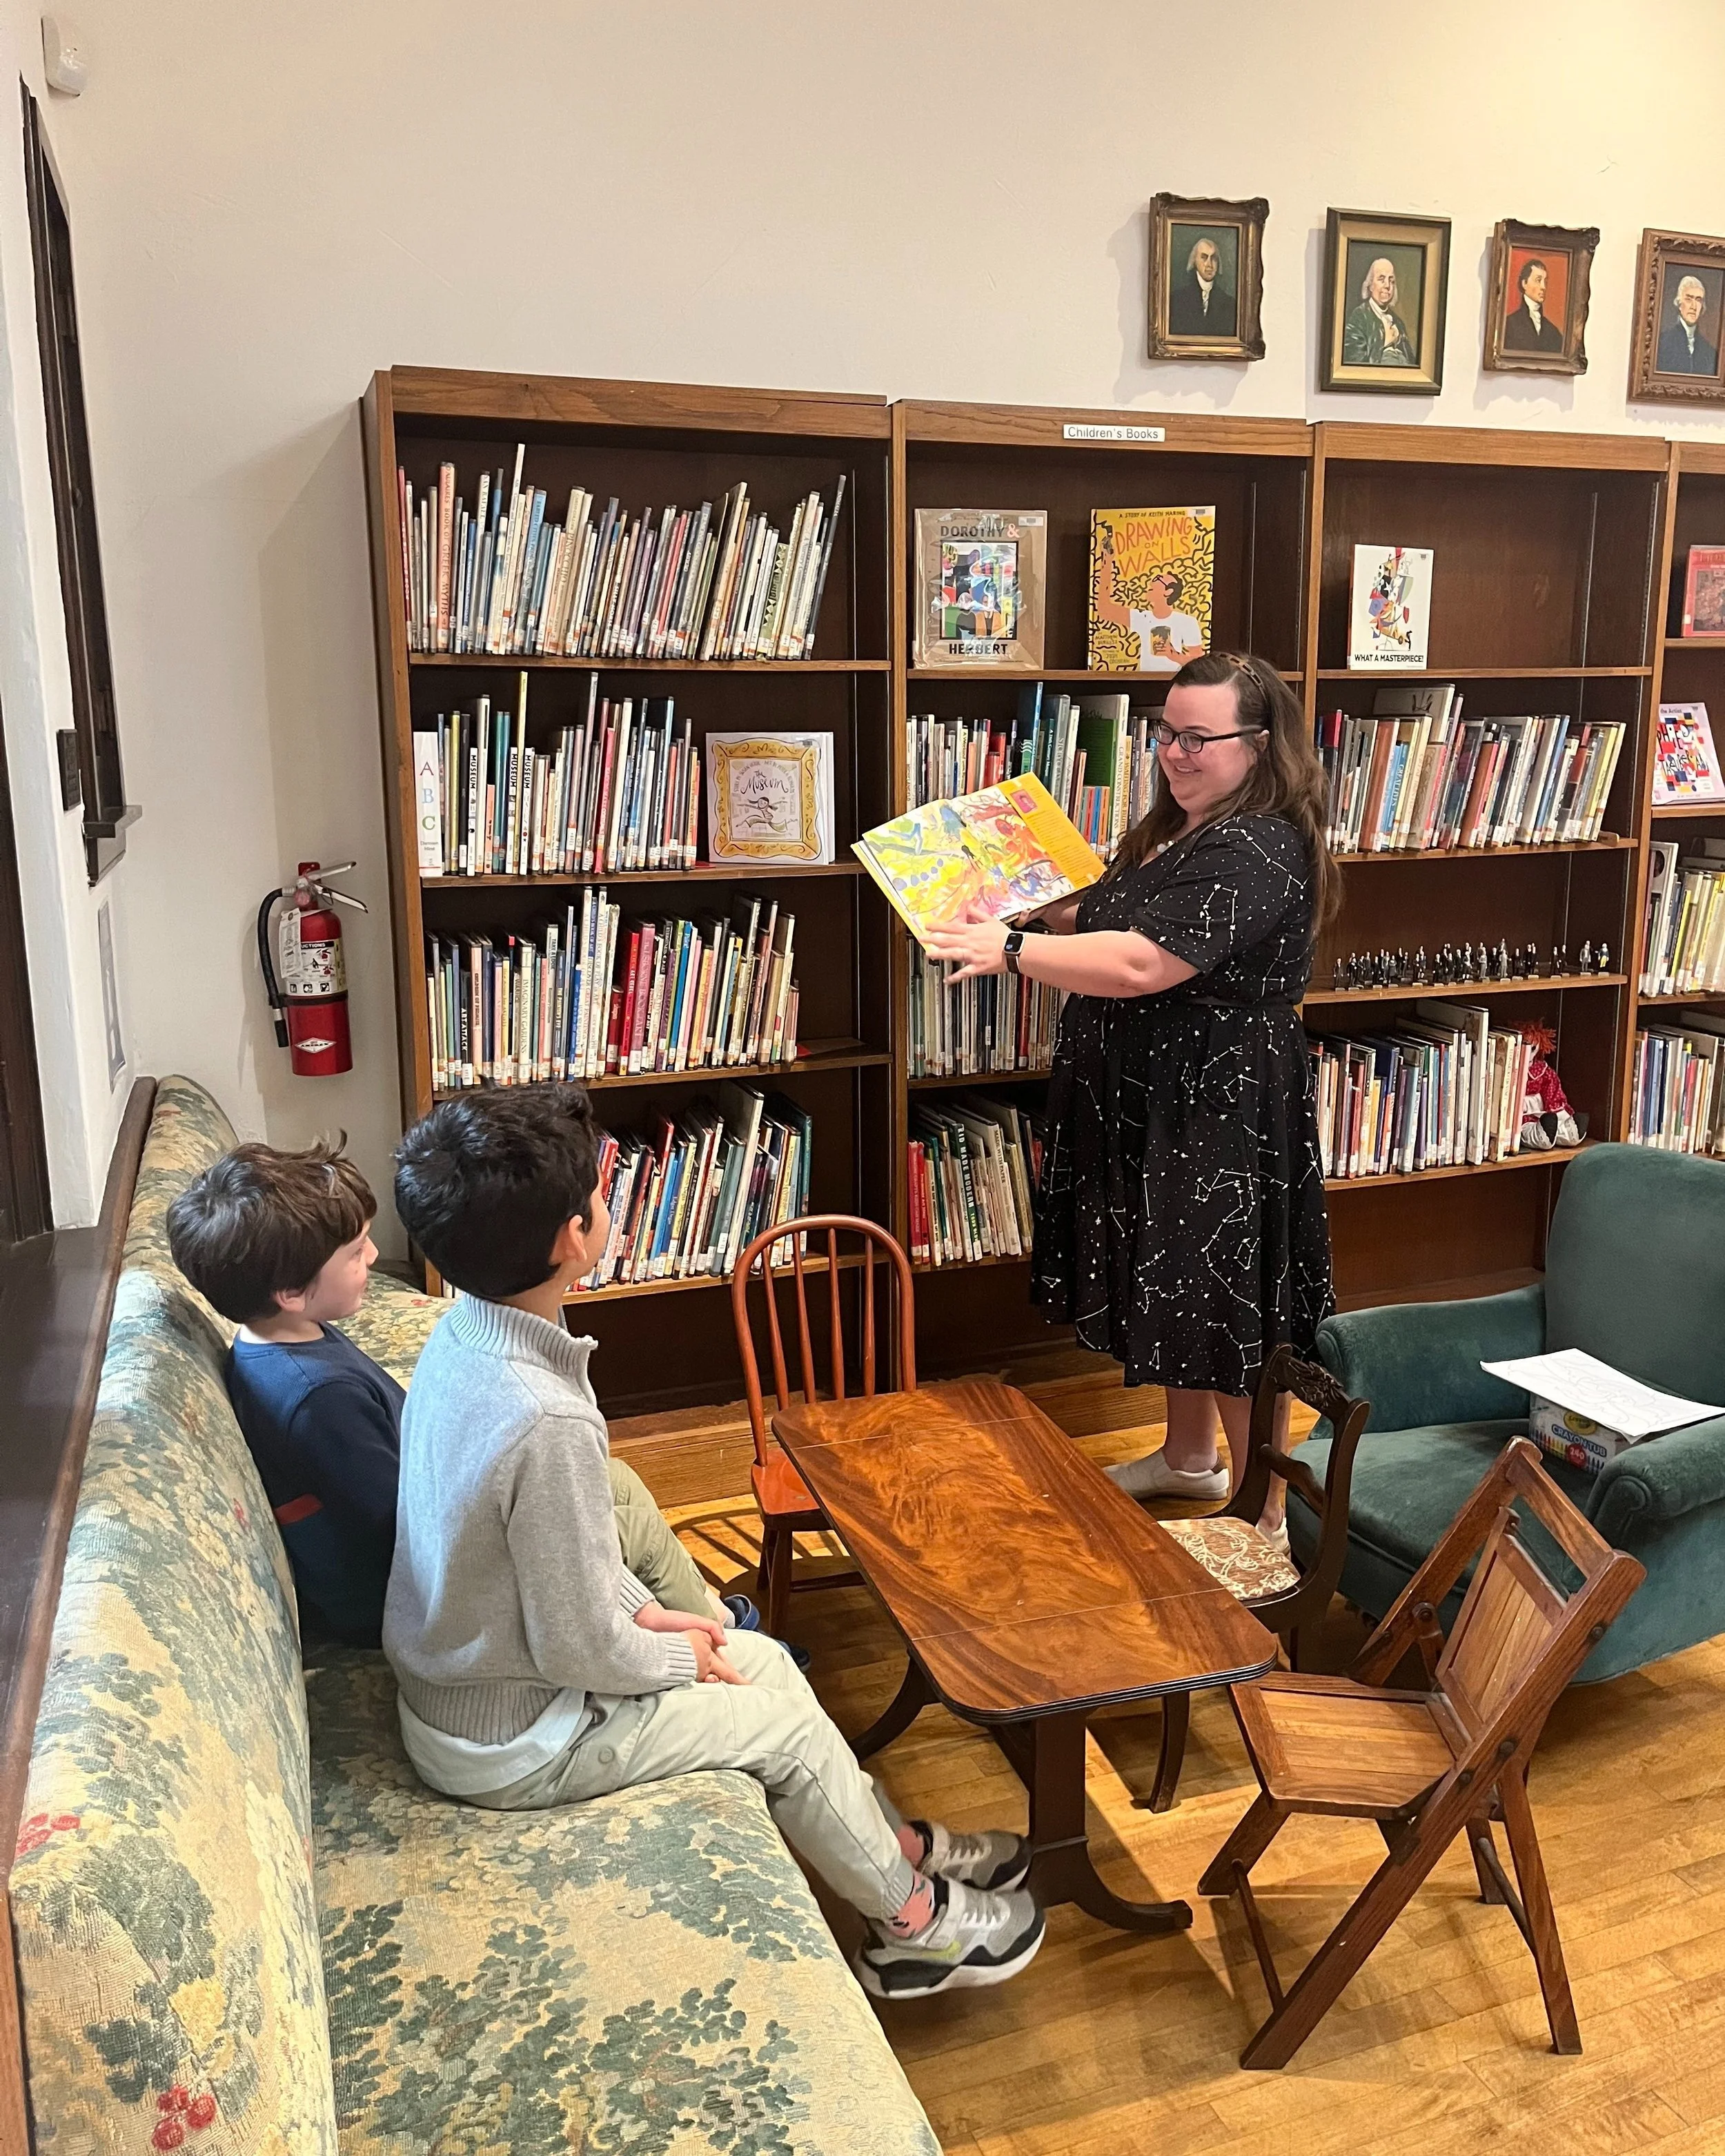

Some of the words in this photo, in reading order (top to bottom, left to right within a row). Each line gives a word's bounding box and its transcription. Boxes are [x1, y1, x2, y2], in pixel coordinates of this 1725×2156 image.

[1068, 427, 1122, 438] Children's
[1127, 428, 1159, 439] Books
[480, 491, 488, 519] RAFAEL
[834, 491, 842, 517] ANIMALIA
[940, 526, 1004, 537] DOROTHY
[1007, 523, 1020, 538] &
[1115, 517, 1192, 555] DRAWING
[1118, 536, 1190, 578] WALLS
[1145, 540, 1159, 549] ON
[442, 544, 450, 578] GREEK
[560, 533, 575, 583] PINOCCHIO
[441, 581, 449, 616] MYTHS
[949, 643, 1007, 654] HERBERT
[420, 762, 434, 776] A
[422, 789, 434, 803] B
[740, 776, 789, 794] Museum
[1114, 774, 1123, 829] CONSTRUCTIONS
[422, 816, 435, 831] C
[639, 950, 650, 986] USBORNE
[638, 989, 646, 1012] BOOK
[655, 975, 664, 1016] PERSPECTIVE
[635, 1019, 644, 1037] ART
[960, 1147, 969, 1171] MADE
[964, 1174, 974, 1208] MODERN
[1552, 1425, 1587, 1449] CRAYON
[1588, 1441, 1606, 1456] TUB
[1570, 1447, 1585, 1460] 240
